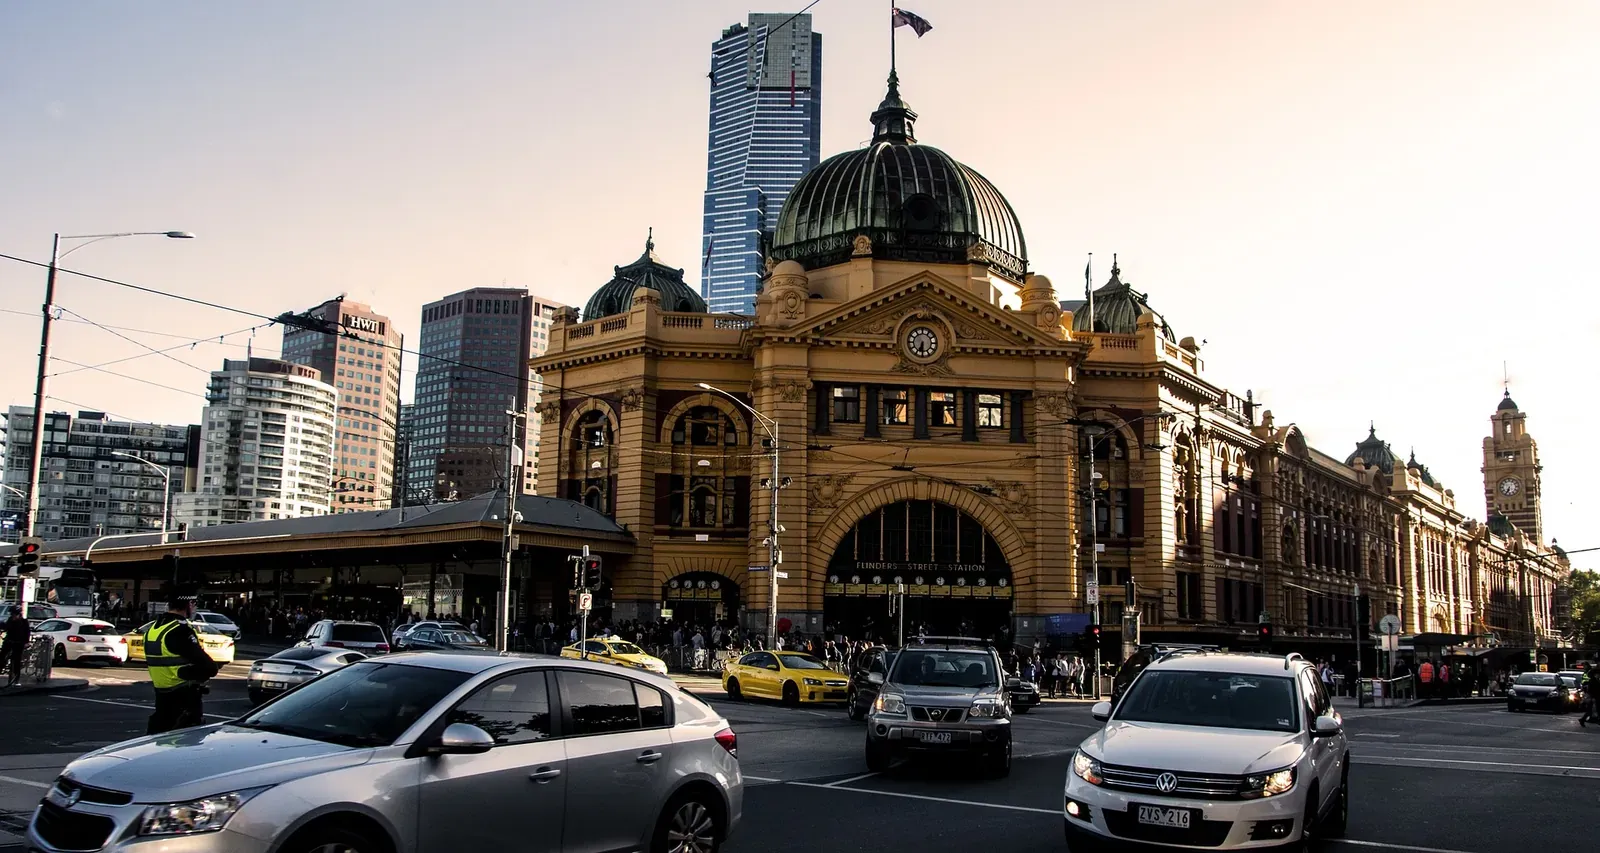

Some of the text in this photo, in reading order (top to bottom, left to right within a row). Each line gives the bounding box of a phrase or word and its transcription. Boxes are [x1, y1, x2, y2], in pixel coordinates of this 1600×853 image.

[351, 316, 377, 331] HWT
[298, 366, 316, 379] WEST
[856, 562, 985, 572] FLINDERS STREET STATION
[1140, 807, 1160, 821] ZVS
[1168, 810, 1188, 824] 216
